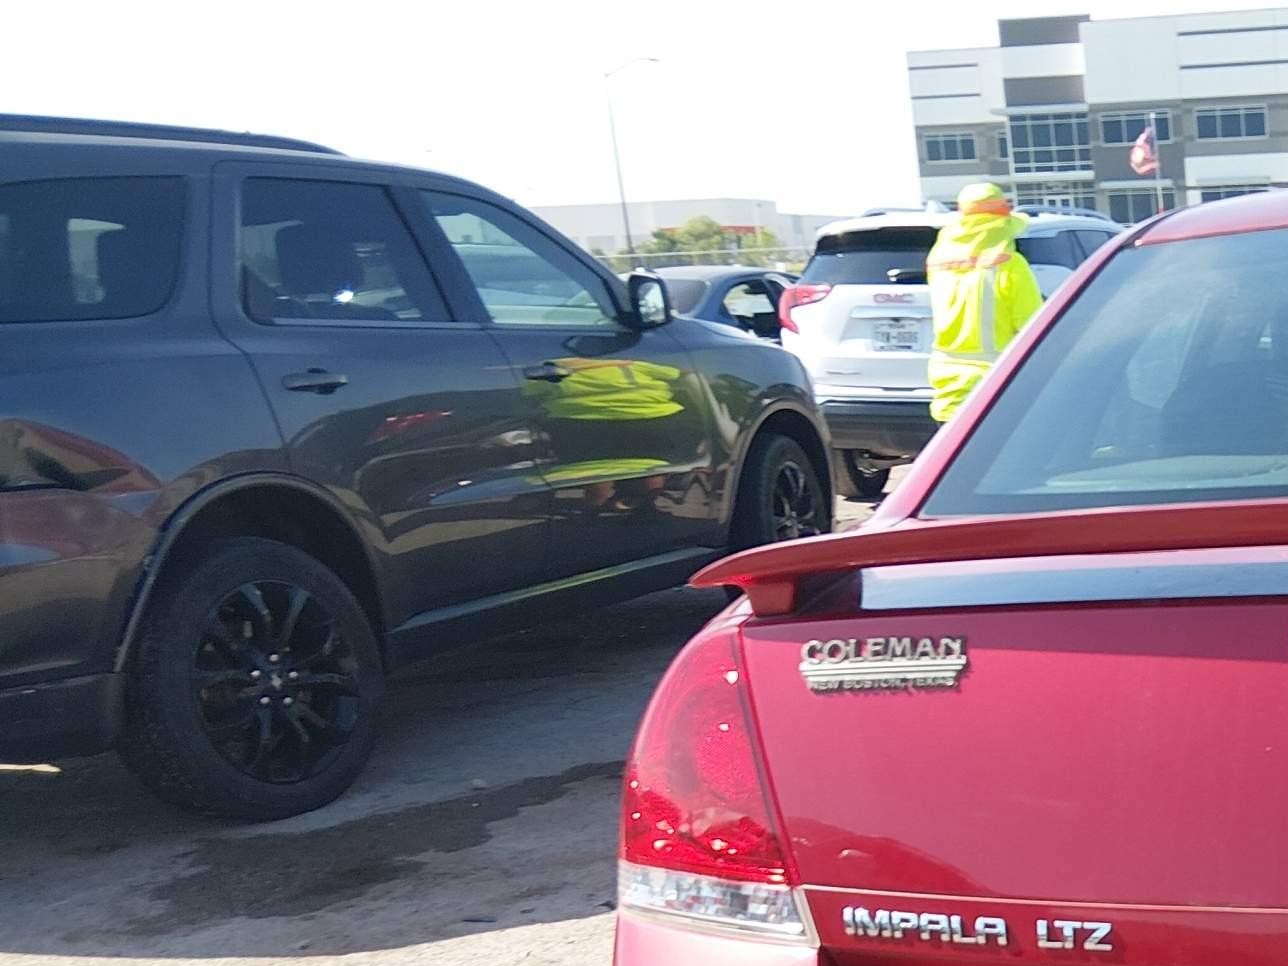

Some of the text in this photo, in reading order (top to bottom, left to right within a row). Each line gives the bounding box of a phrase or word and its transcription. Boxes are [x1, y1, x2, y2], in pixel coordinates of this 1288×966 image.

[801, 637, 962, 664] COLEMAN
[843, 906, 1113, 951] IMPALA LTZ
